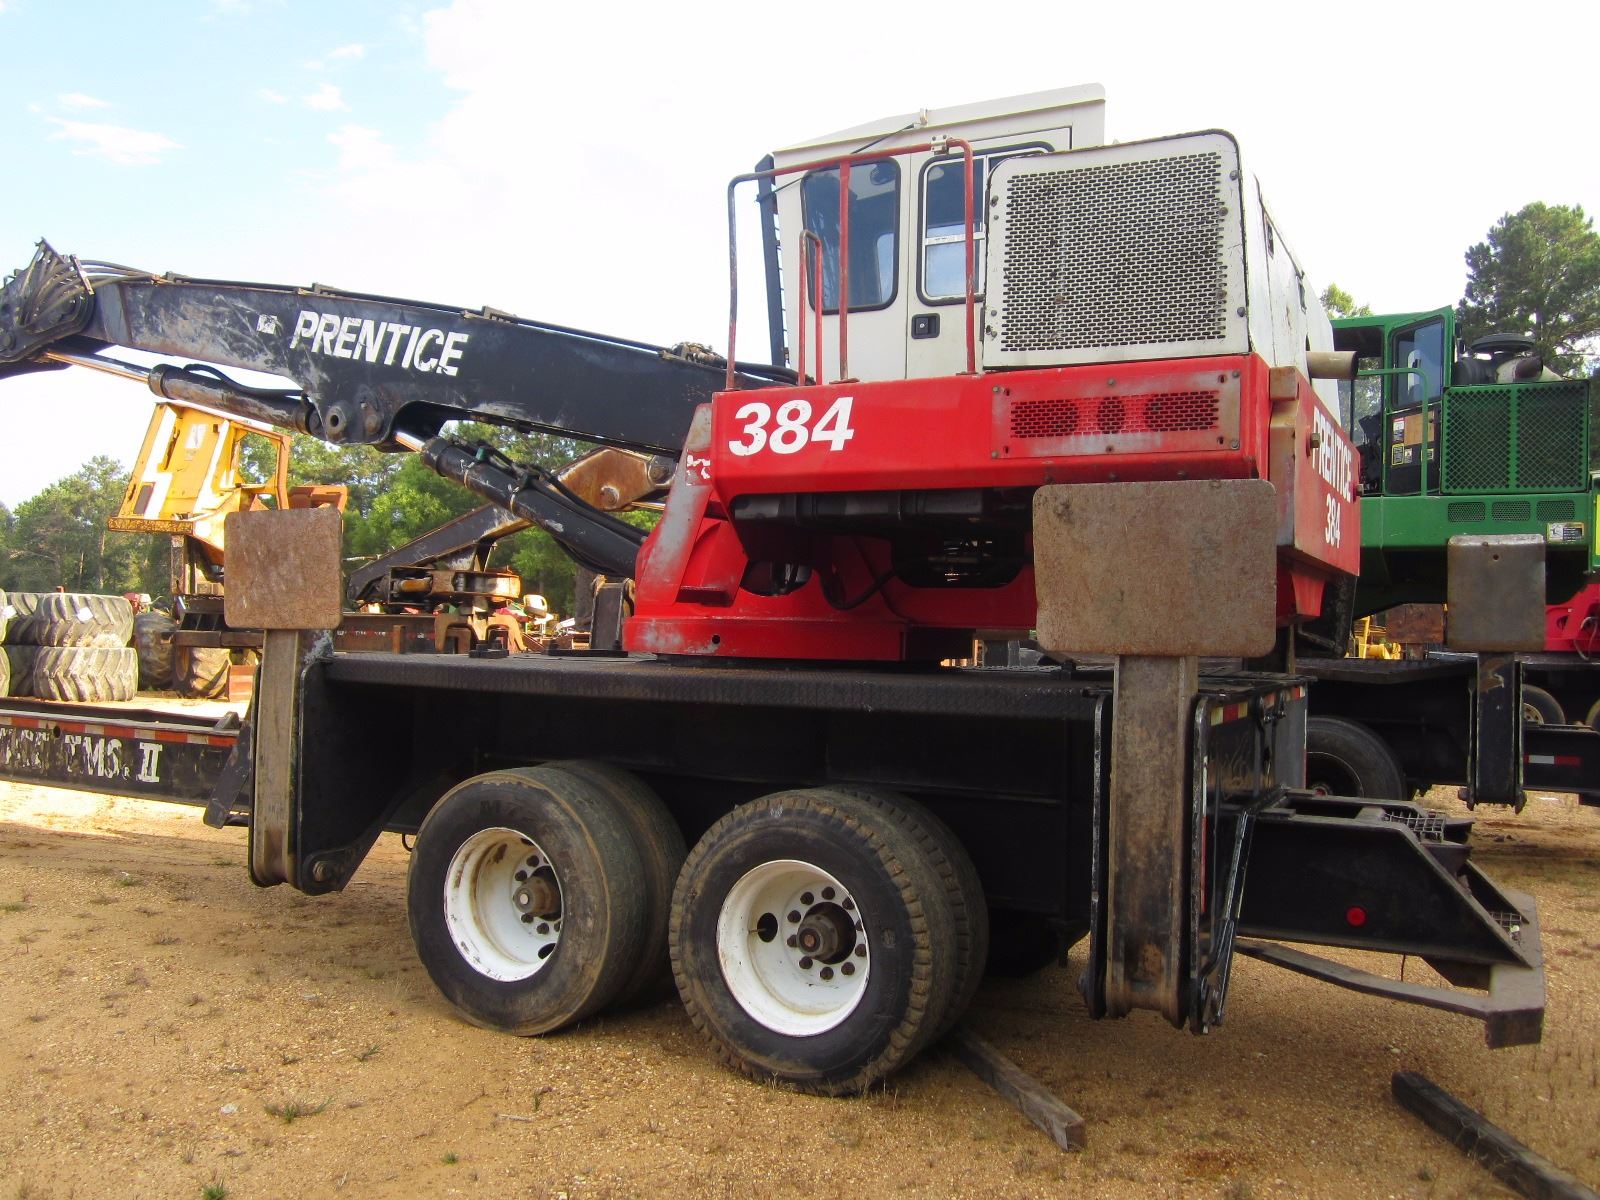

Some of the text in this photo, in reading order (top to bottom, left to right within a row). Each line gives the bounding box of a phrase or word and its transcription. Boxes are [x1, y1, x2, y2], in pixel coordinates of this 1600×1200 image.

[289, 310, 470, 377] PRENTICE
[728, 396, 855, 456] 384
[1312, 405, 1353, 504] PRENTICE
[1325, 493, 1341, 549] 384
